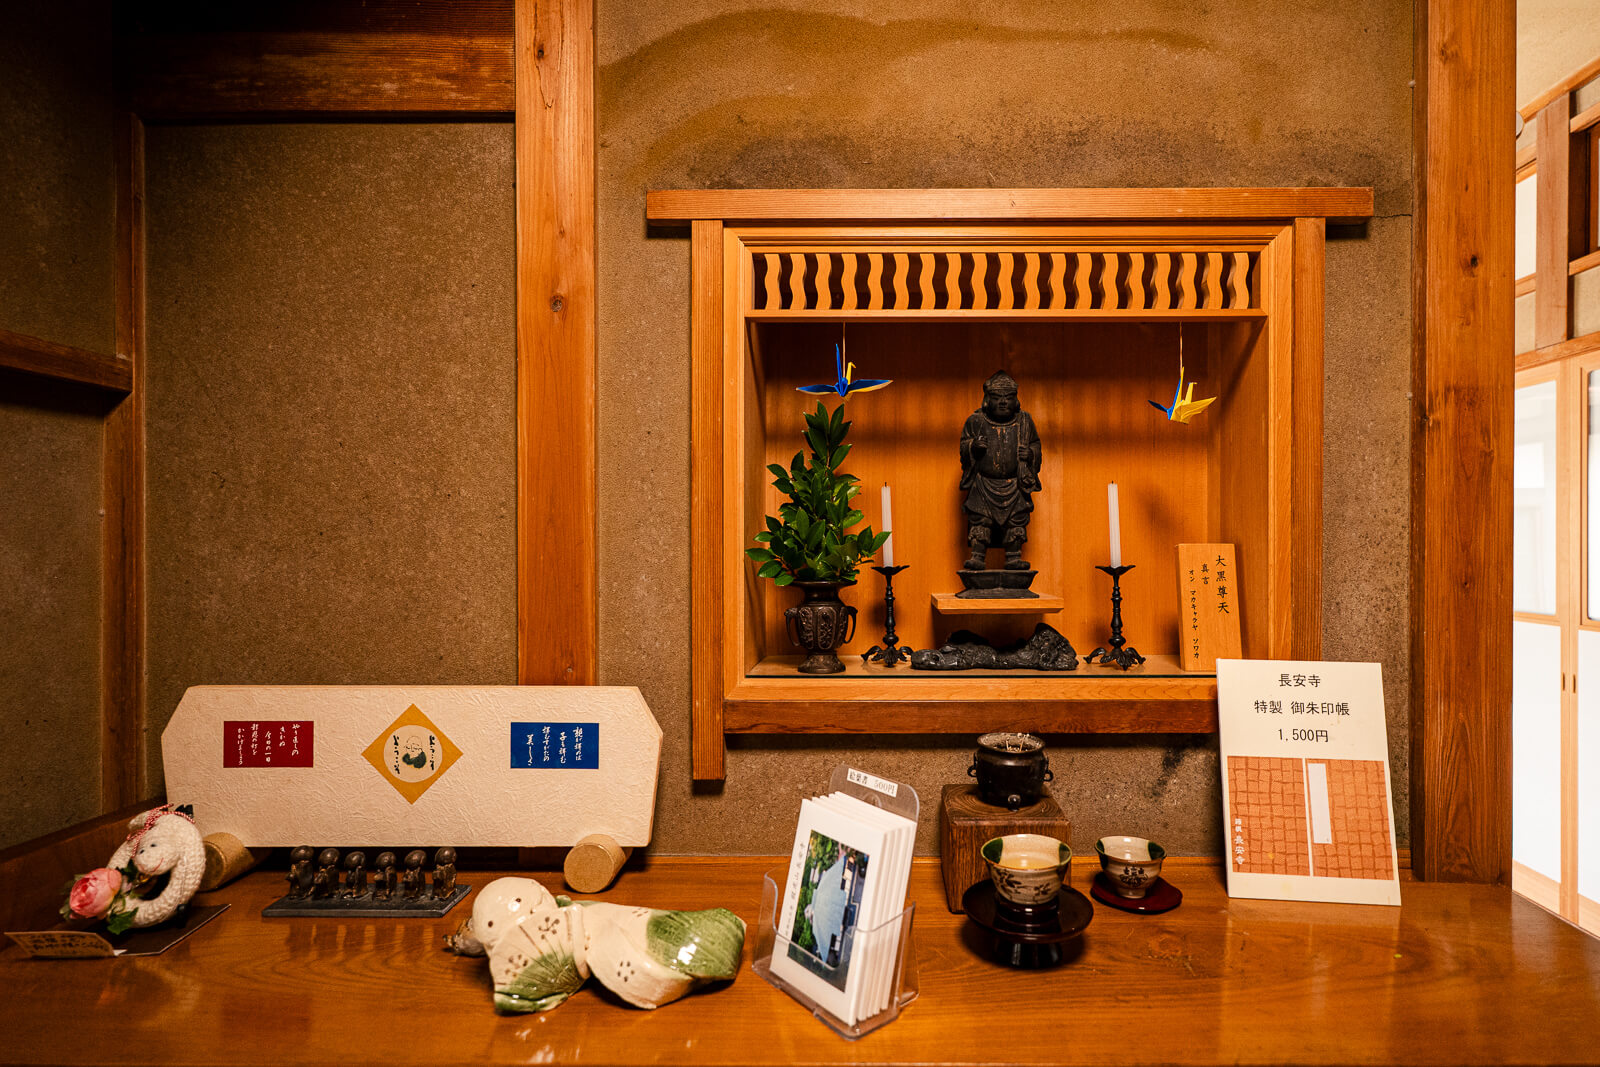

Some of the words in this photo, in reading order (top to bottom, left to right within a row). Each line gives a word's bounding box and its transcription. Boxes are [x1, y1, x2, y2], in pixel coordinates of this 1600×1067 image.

[1200, 563, 1210, 585] 真言
[1215, 554, 1230, 614] 大黒尊天
[1278, 673, 1321, 688] 長安寺
[1253, 699, 1283, 715] 特製
[1290, 700, 1350, 716] 御朱印帳
